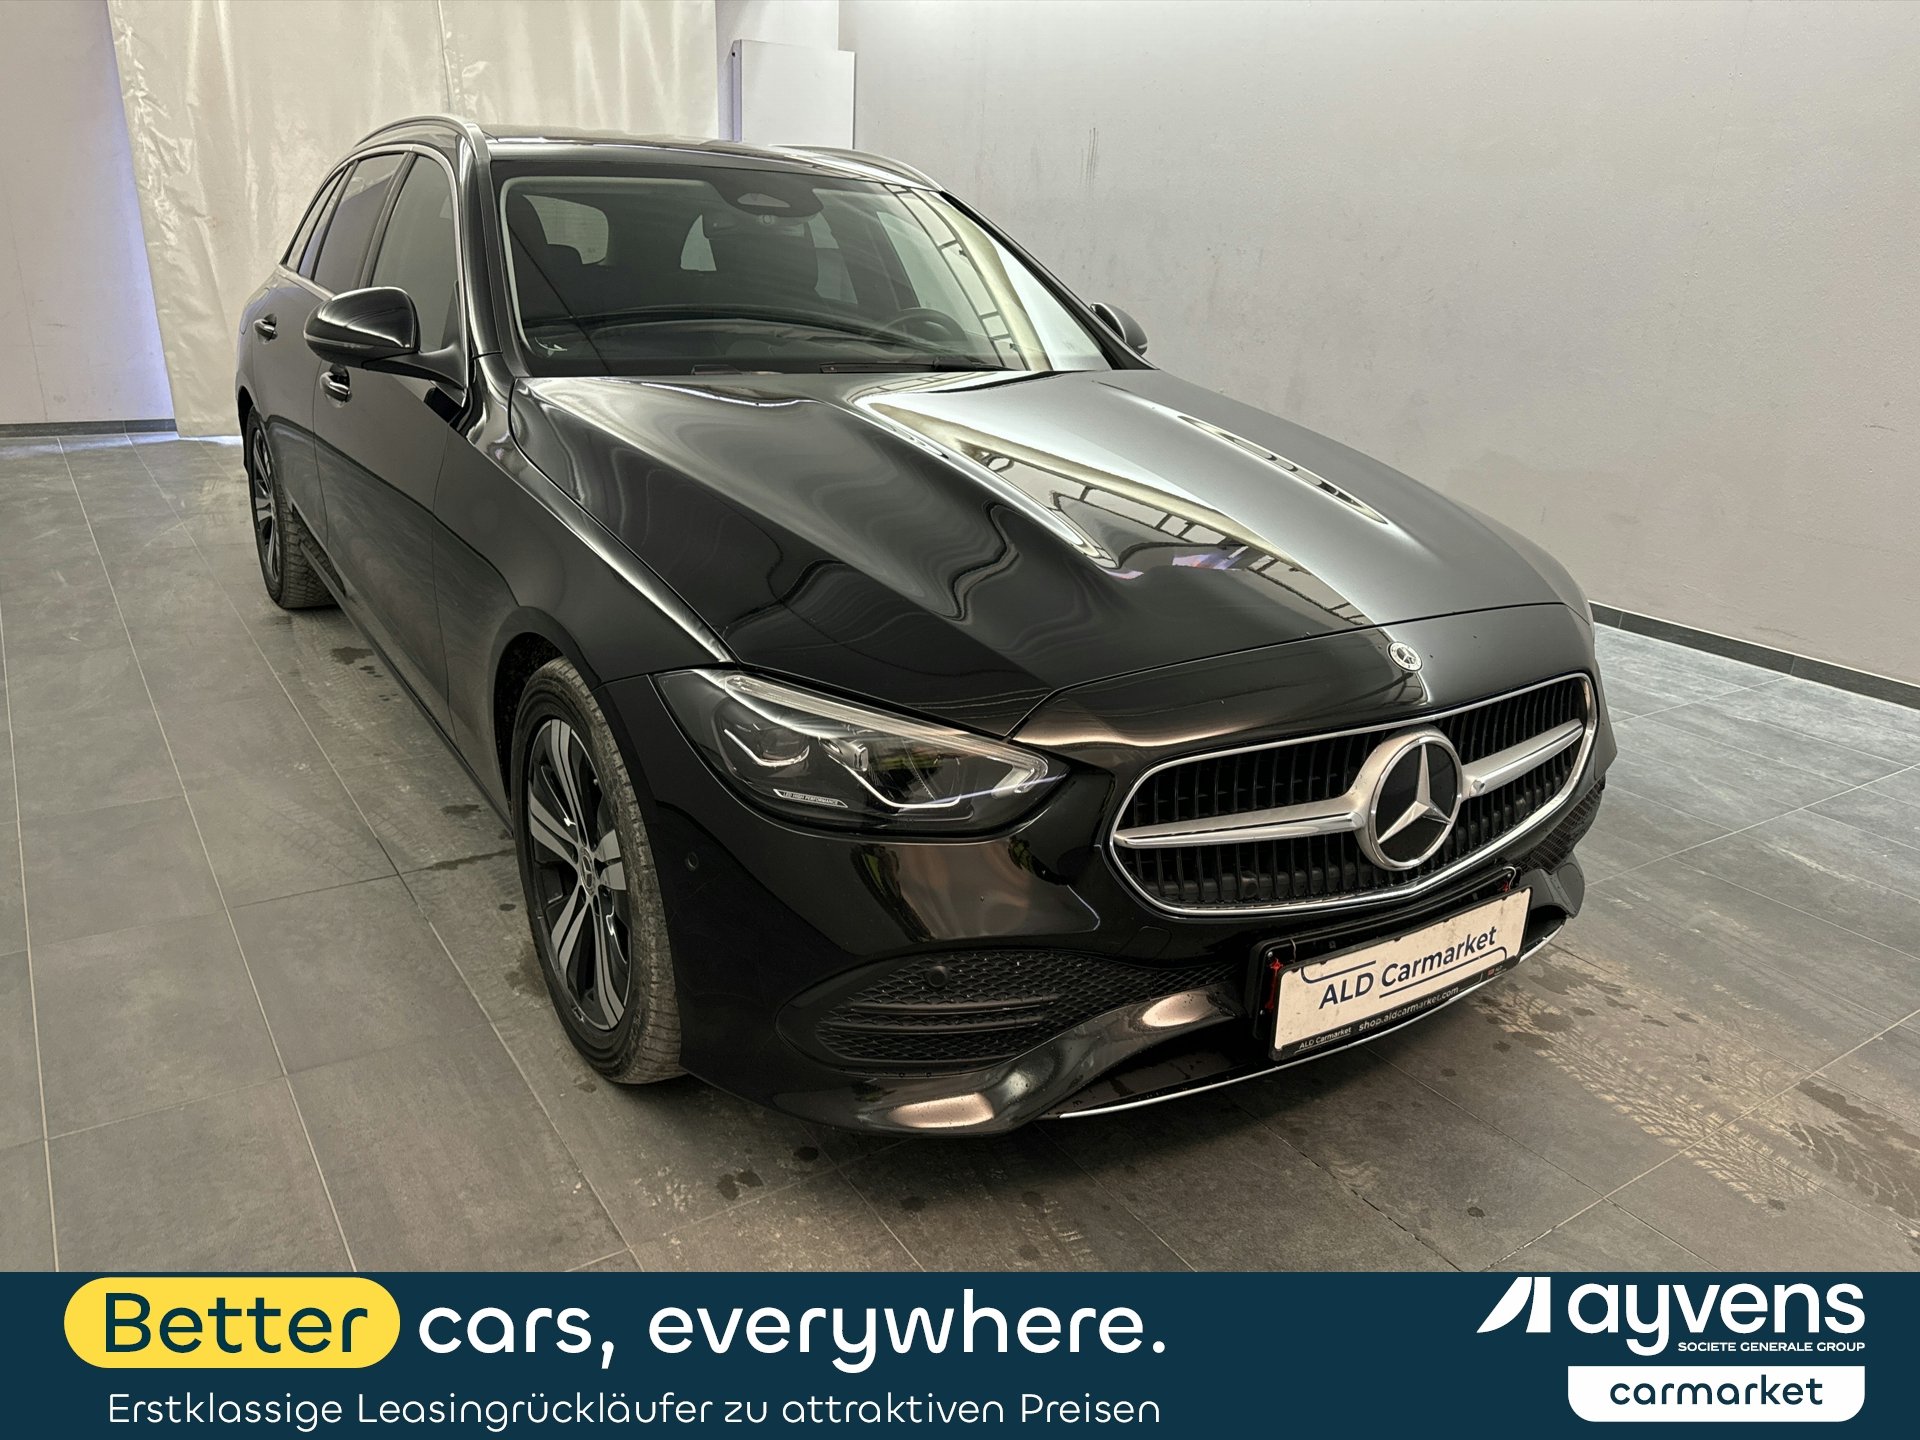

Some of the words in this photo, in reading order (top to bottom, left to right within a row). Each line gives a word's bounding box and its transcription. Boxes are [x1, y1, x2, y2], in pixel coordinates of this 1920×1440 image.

[1318, 972, 1374, 1010] ALD
[1381, 926, 1497, 987] Carmarket
[1358, 987, 1459, 1032] shop.aldcarmarket.com
[1299, 1039, 1315, 1050] ALD
[1315, 1027, 1352, 1044] Carmarket
